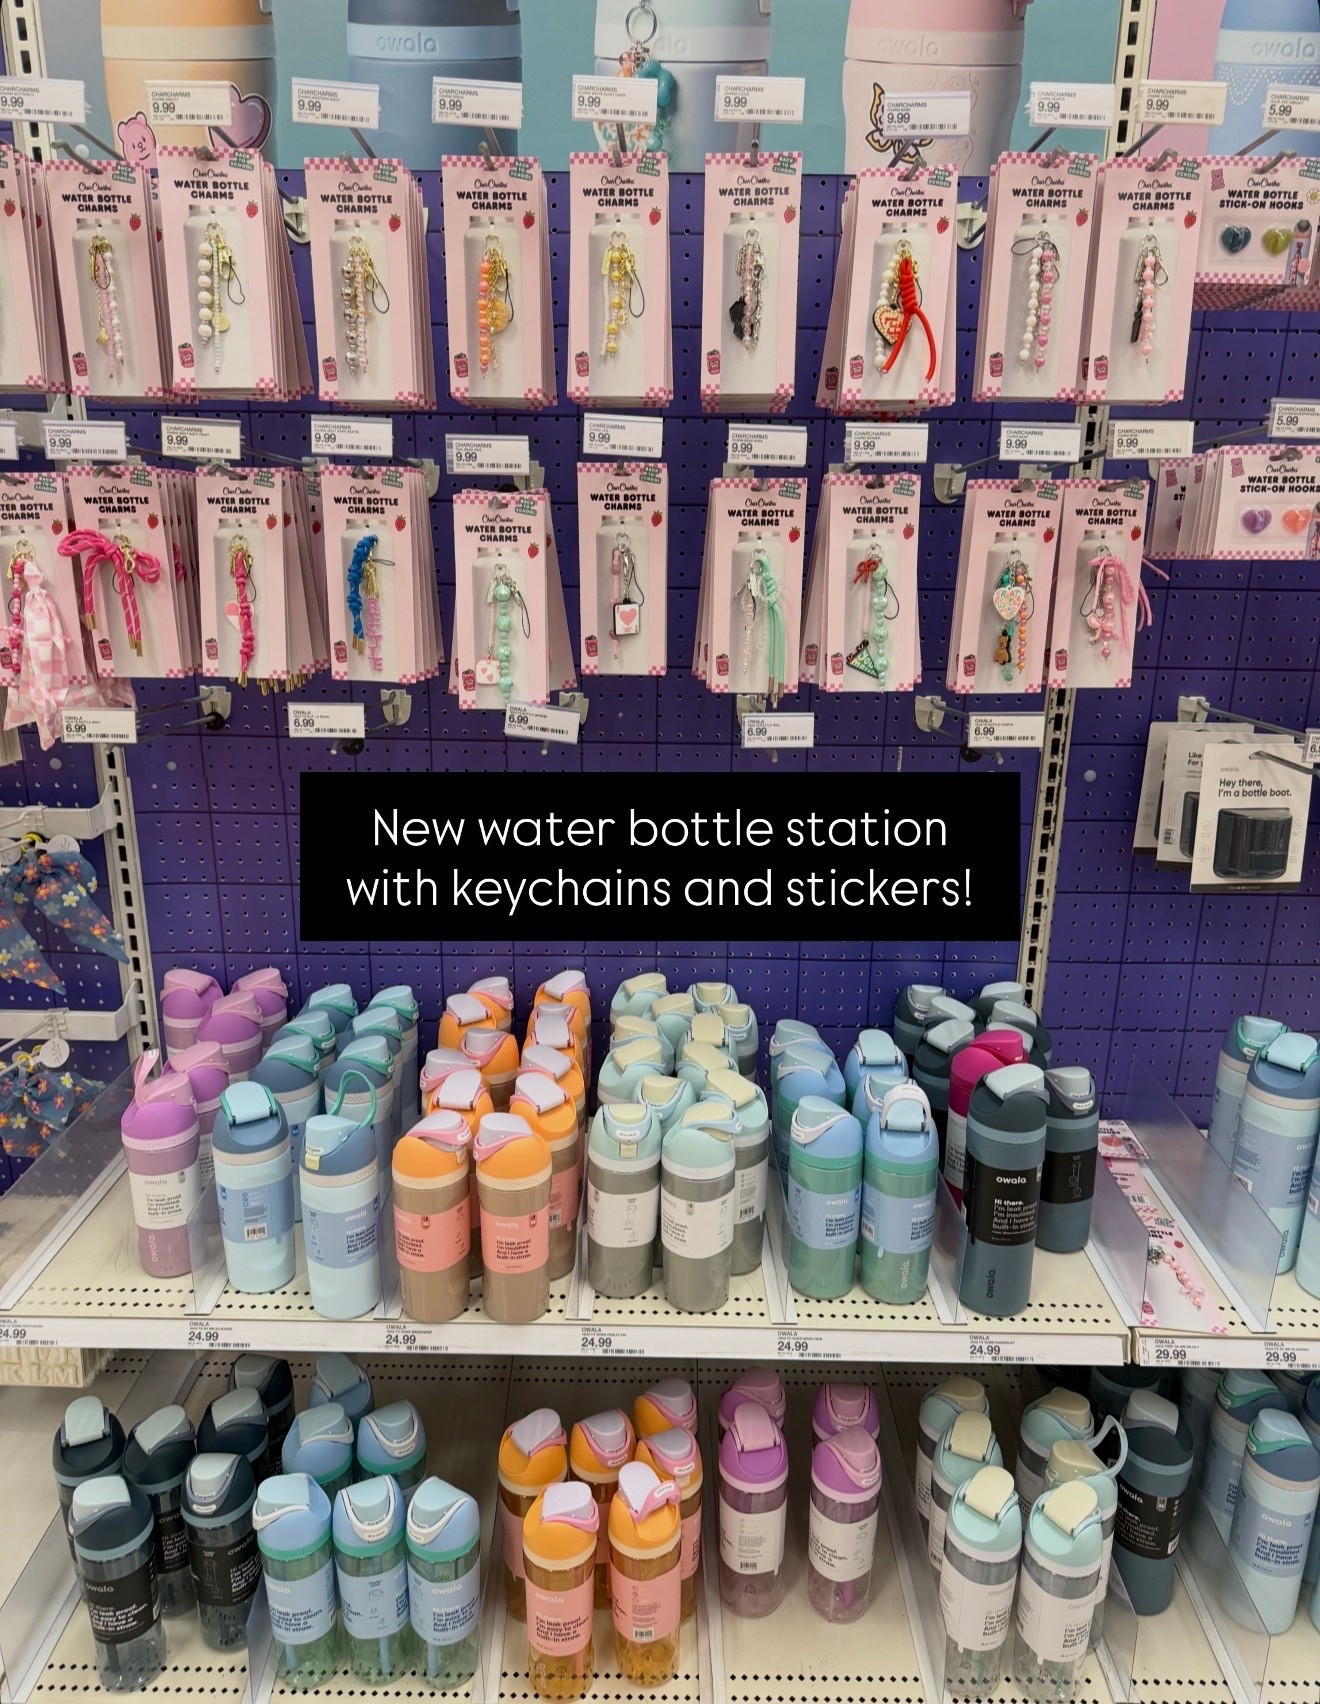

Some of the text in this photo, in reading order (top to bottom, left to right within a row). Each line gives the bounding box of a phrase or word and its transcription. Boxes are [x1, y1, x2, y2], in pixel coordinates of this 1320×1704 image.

[375, 31, 438, 54] owala
[1252, 35, 1316, 59] owala
[298, 88, 338, 98] CHARCHARMS
[0, 96, 24, 108] 9.99
[298, 100, 322, 112] 9.99
[438, 99, 462, 111] 9.99
[578, 96, 600, 107] 9.99
[724, 96, 747, 108] 9.99
[1146, 99, 1169, 110] 9.99
[152, 102, 176, 114] 9.99
[1038, 102, 1060, 112] 9.99
[1269, 105, 1292, 116] 5.99
[887, 112, 910, 124] 9.99
[230, 162, 253, 170] SCHOOL
[174, 180, 249, 190] WATER BOTTLE
[191, 190, 234, 200] CHARMS
[457, 191, 527, 201] WATER BOTTLE
[583, 188, 654, 197] WATER BOTTLE
[719, 187, 790, 197] WATER BOTTLE
[1012, 188, 1083, 198] WATER BOTTLE
[1118, 192, 1191, 201] WATER BOTTLE
[1228, 190, 1298, 200] WATER BOTTLE
[62, 194, 132, 204] WATER BOTTLE
[320, 194, 392, 204] WATER BOTTLE
[598, 198, 638, 207] CHARMS
[734, 197, 774, 206] CHARMS
[872, 198, 944, 208] WATER BOTTLE
[1026, 198, 1067, 208] CHARMS
[78, 204, 118, 213] CHARMS
[336, 205, 378, 214] CHARMS
[472, 202, 512, 210] CHARMS
[1132, 201, 1174, 210] CHARMS
[1219, 200, 1304, 210] STICK-ON HOOKS
[886, 208, 928, 217] CHARMS
[1276, 416, 1298, 426] 5.99
[166, 436, 188, 446] 9.99
[314, 433, 336, 444] 9.99
[589, 432, 610, 443] 9.99
[49, 438, 72, 448] 9.99
[732, 442, 753, 453] 9.99
[854, 440, 876, 450] 9.99
[1006, 439, 1028, 450] 9.99
[1117, 438, 1138, 448] 9.99
[456, 452, 478, 462] 9.99
[1248, 475, 1316, 485] WATER BOTTLE
[1240, 484, 1320, 494] STICK-ON HOOKS
[84, 496, 149, 506] WATER BOTTLE
[207, 497, 270, 506] WATER BOTTLE
[334, 496, 398, 506] WATER BOTTLE
[590, 493, 656, 502] WATER BOTTLE
[99, 506, 136, 514] CHARMS
[220, 506, 257, 514] CHARMS
[348, 506, 385, 515] CHARMS
[604, 502, 642, 511] CHARMS
[842, 506, 908, 516] WATER BOTTLE
[728, 509, 794, 518] WATER BOTTLE
[1076, 508, 1137, 518] WATER BOTTLE
[741, 518, 780, 527] CHARMS
[856, 515, 894, 524] CHARMS
[1088, 517, 1124, 526] CHARMS
[466, 525, 532, 534] WATER BOTTLE
[480, 534, 518, 543] CHARMS
[294, 718, 314, 728] 6.99
[508, 714, 528, 724] 6.99
[66, 723, 86, 733] 6.99
[748, 727, 768, 736] 6.99
[974, 727, 994, 736] 6.99
[1220, 779, 1262, 788] Hey there,
[1218, 788, 1232, 797] I'm
[1242, 788, 1268, 797] bottle
[1270, 788, 1292, 797] boot.
[996, 1176, 1026, 1184] owala
[188, 1331, 219, 1342] 24.99
[386, 1334, 416, 1344] 24.99
[582, 1338, 612, 1348] 24.99
[778, 1342, 808, 1352] 24.99
[970, 1346, 1000, 1356] 24.99
[1156, 1350, 1186, 1360] 29.99
[1266, 1352, 1296, 1362] 29.99
[1262, 1513, 1292, 1527] owala
